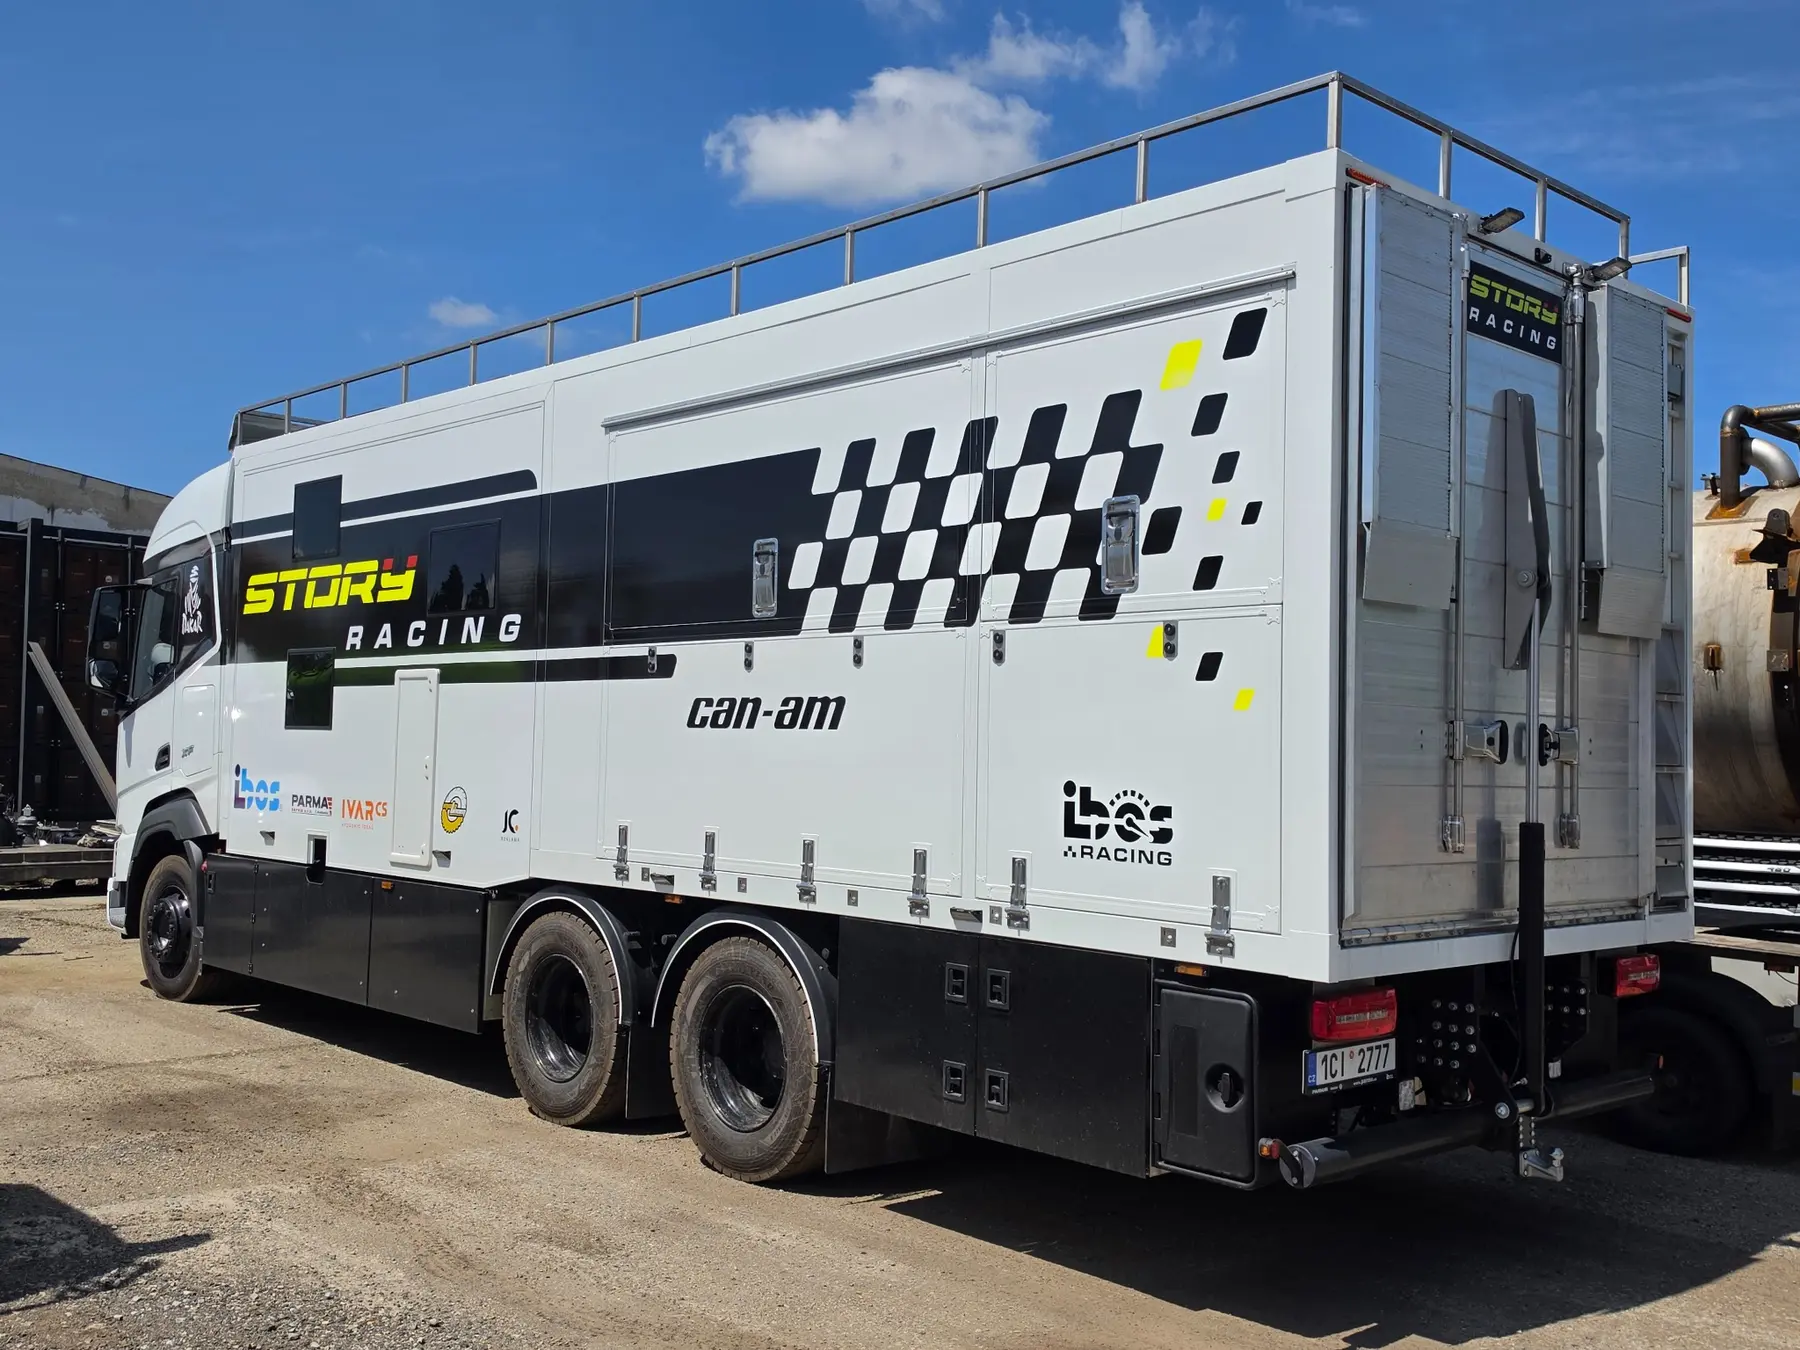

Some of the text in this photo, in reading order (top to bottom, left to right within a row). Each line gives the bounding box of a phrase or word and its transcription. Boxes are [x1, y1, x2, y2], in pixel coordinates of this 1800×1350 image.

[1470, 274, 1559, 325] STORY
[1469, 306, 1557, 350] RACING
[243, 555, 418, 614] STORY
[182, 610, 203, 635] DAKAR
[346, 613, 522, 650] RACING
[687, 696, 846, 730] can-am
[291, 794, 329, 809] PARMA
[1080, 845, 1172, 866] RACING
[1308, 1074, 1316, 1083] CZ
[1321, 1043, 1389, 1080] 1CI 2777
